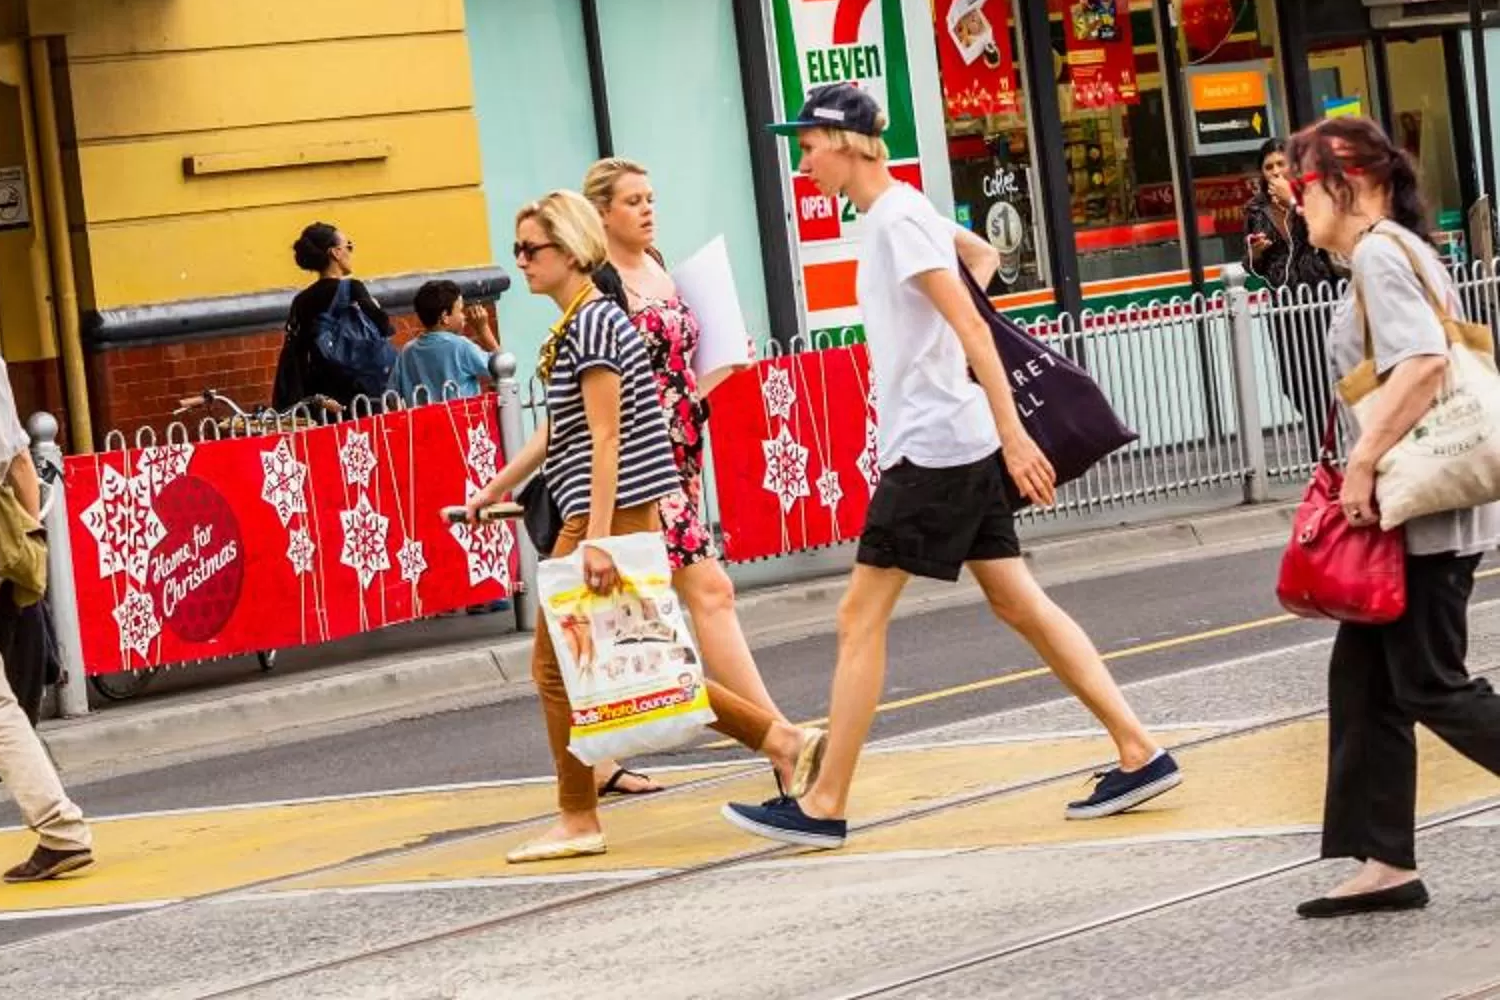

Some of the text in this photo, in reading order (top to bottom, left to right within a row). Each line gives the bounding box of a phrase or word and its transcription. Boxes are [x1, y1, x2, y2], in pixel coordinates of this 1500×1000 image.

[801, 191, 860, 222] OPEN 2
[991, 205, 1012, 247] $1
[151, 524, 213, 584] Home for
[164, 540, 237, 617] Christmas
